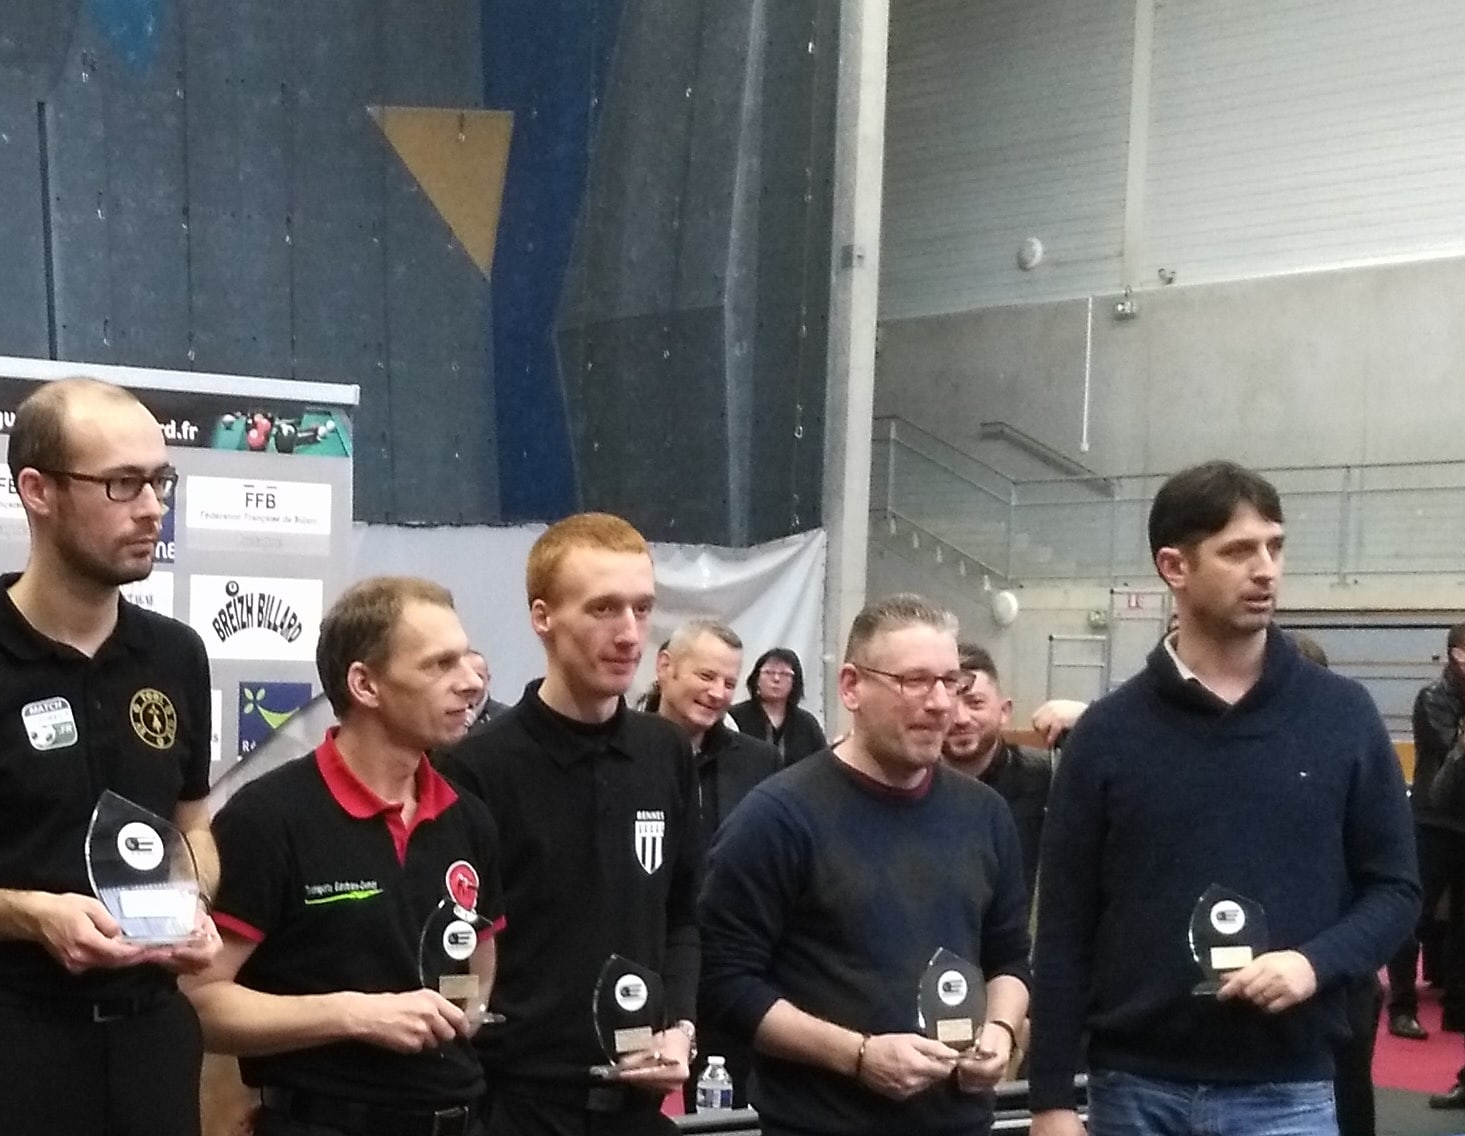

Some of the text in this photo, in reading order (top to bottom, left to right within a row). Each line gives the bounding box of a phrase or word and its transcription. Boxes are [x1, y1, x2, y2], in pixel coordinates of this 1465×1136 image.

[245, 492, 276, 509] FFB
[211, 593, 302, 643] BREIZH BILLARD
